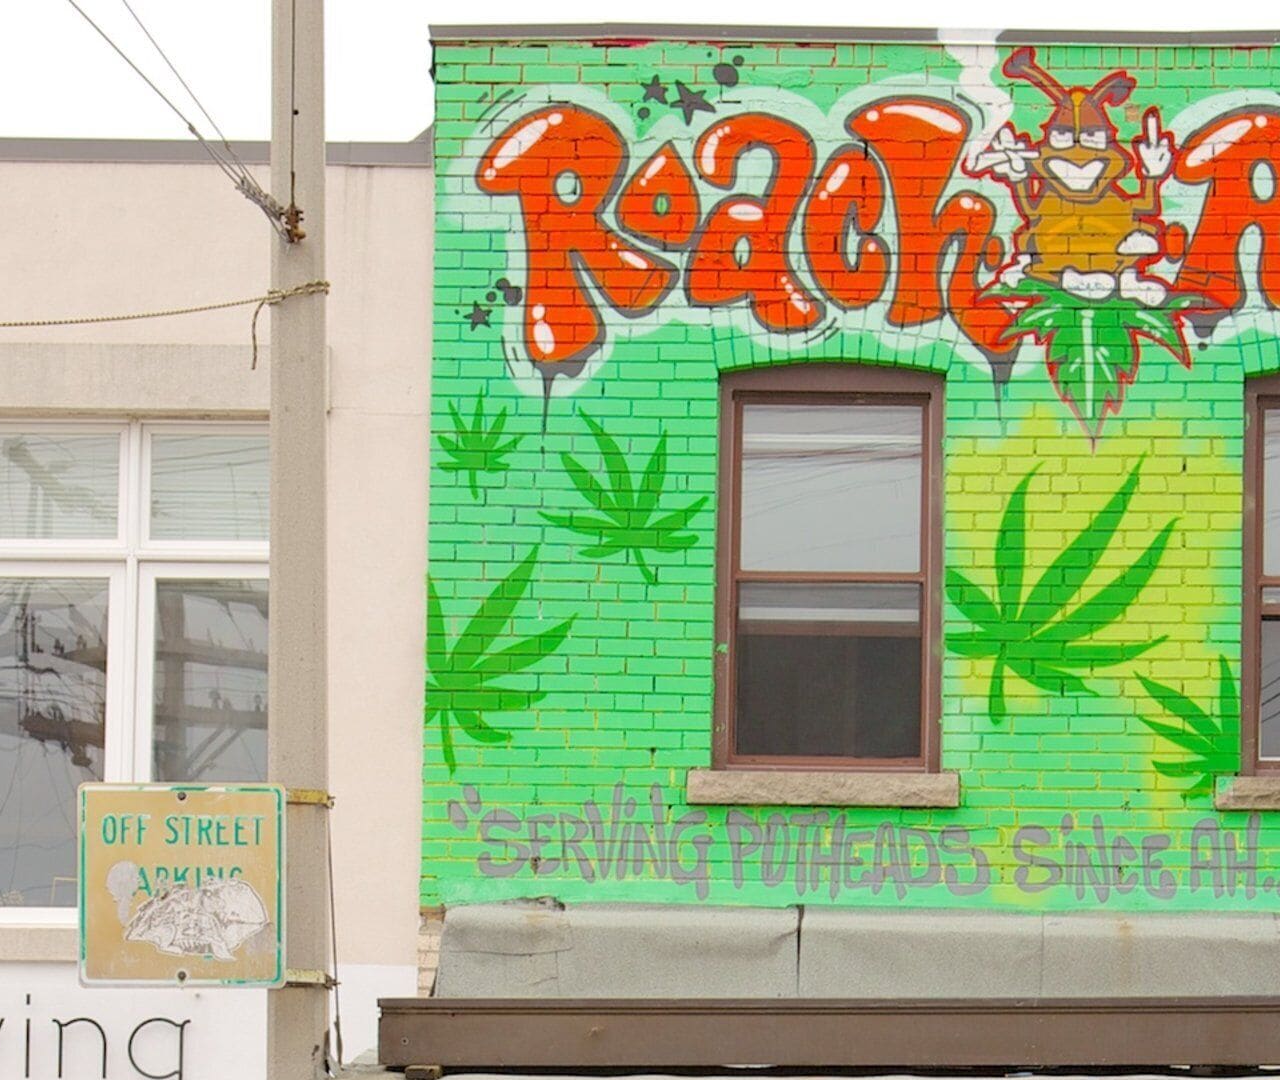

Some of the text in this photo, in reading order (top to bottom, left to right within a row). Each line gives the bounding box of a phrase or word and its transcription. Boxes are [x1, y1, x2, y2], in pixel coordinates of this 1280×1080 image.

[102, 815, 267, 846] OFF STREET
[725, 806, 990, 898] POTHEADS
